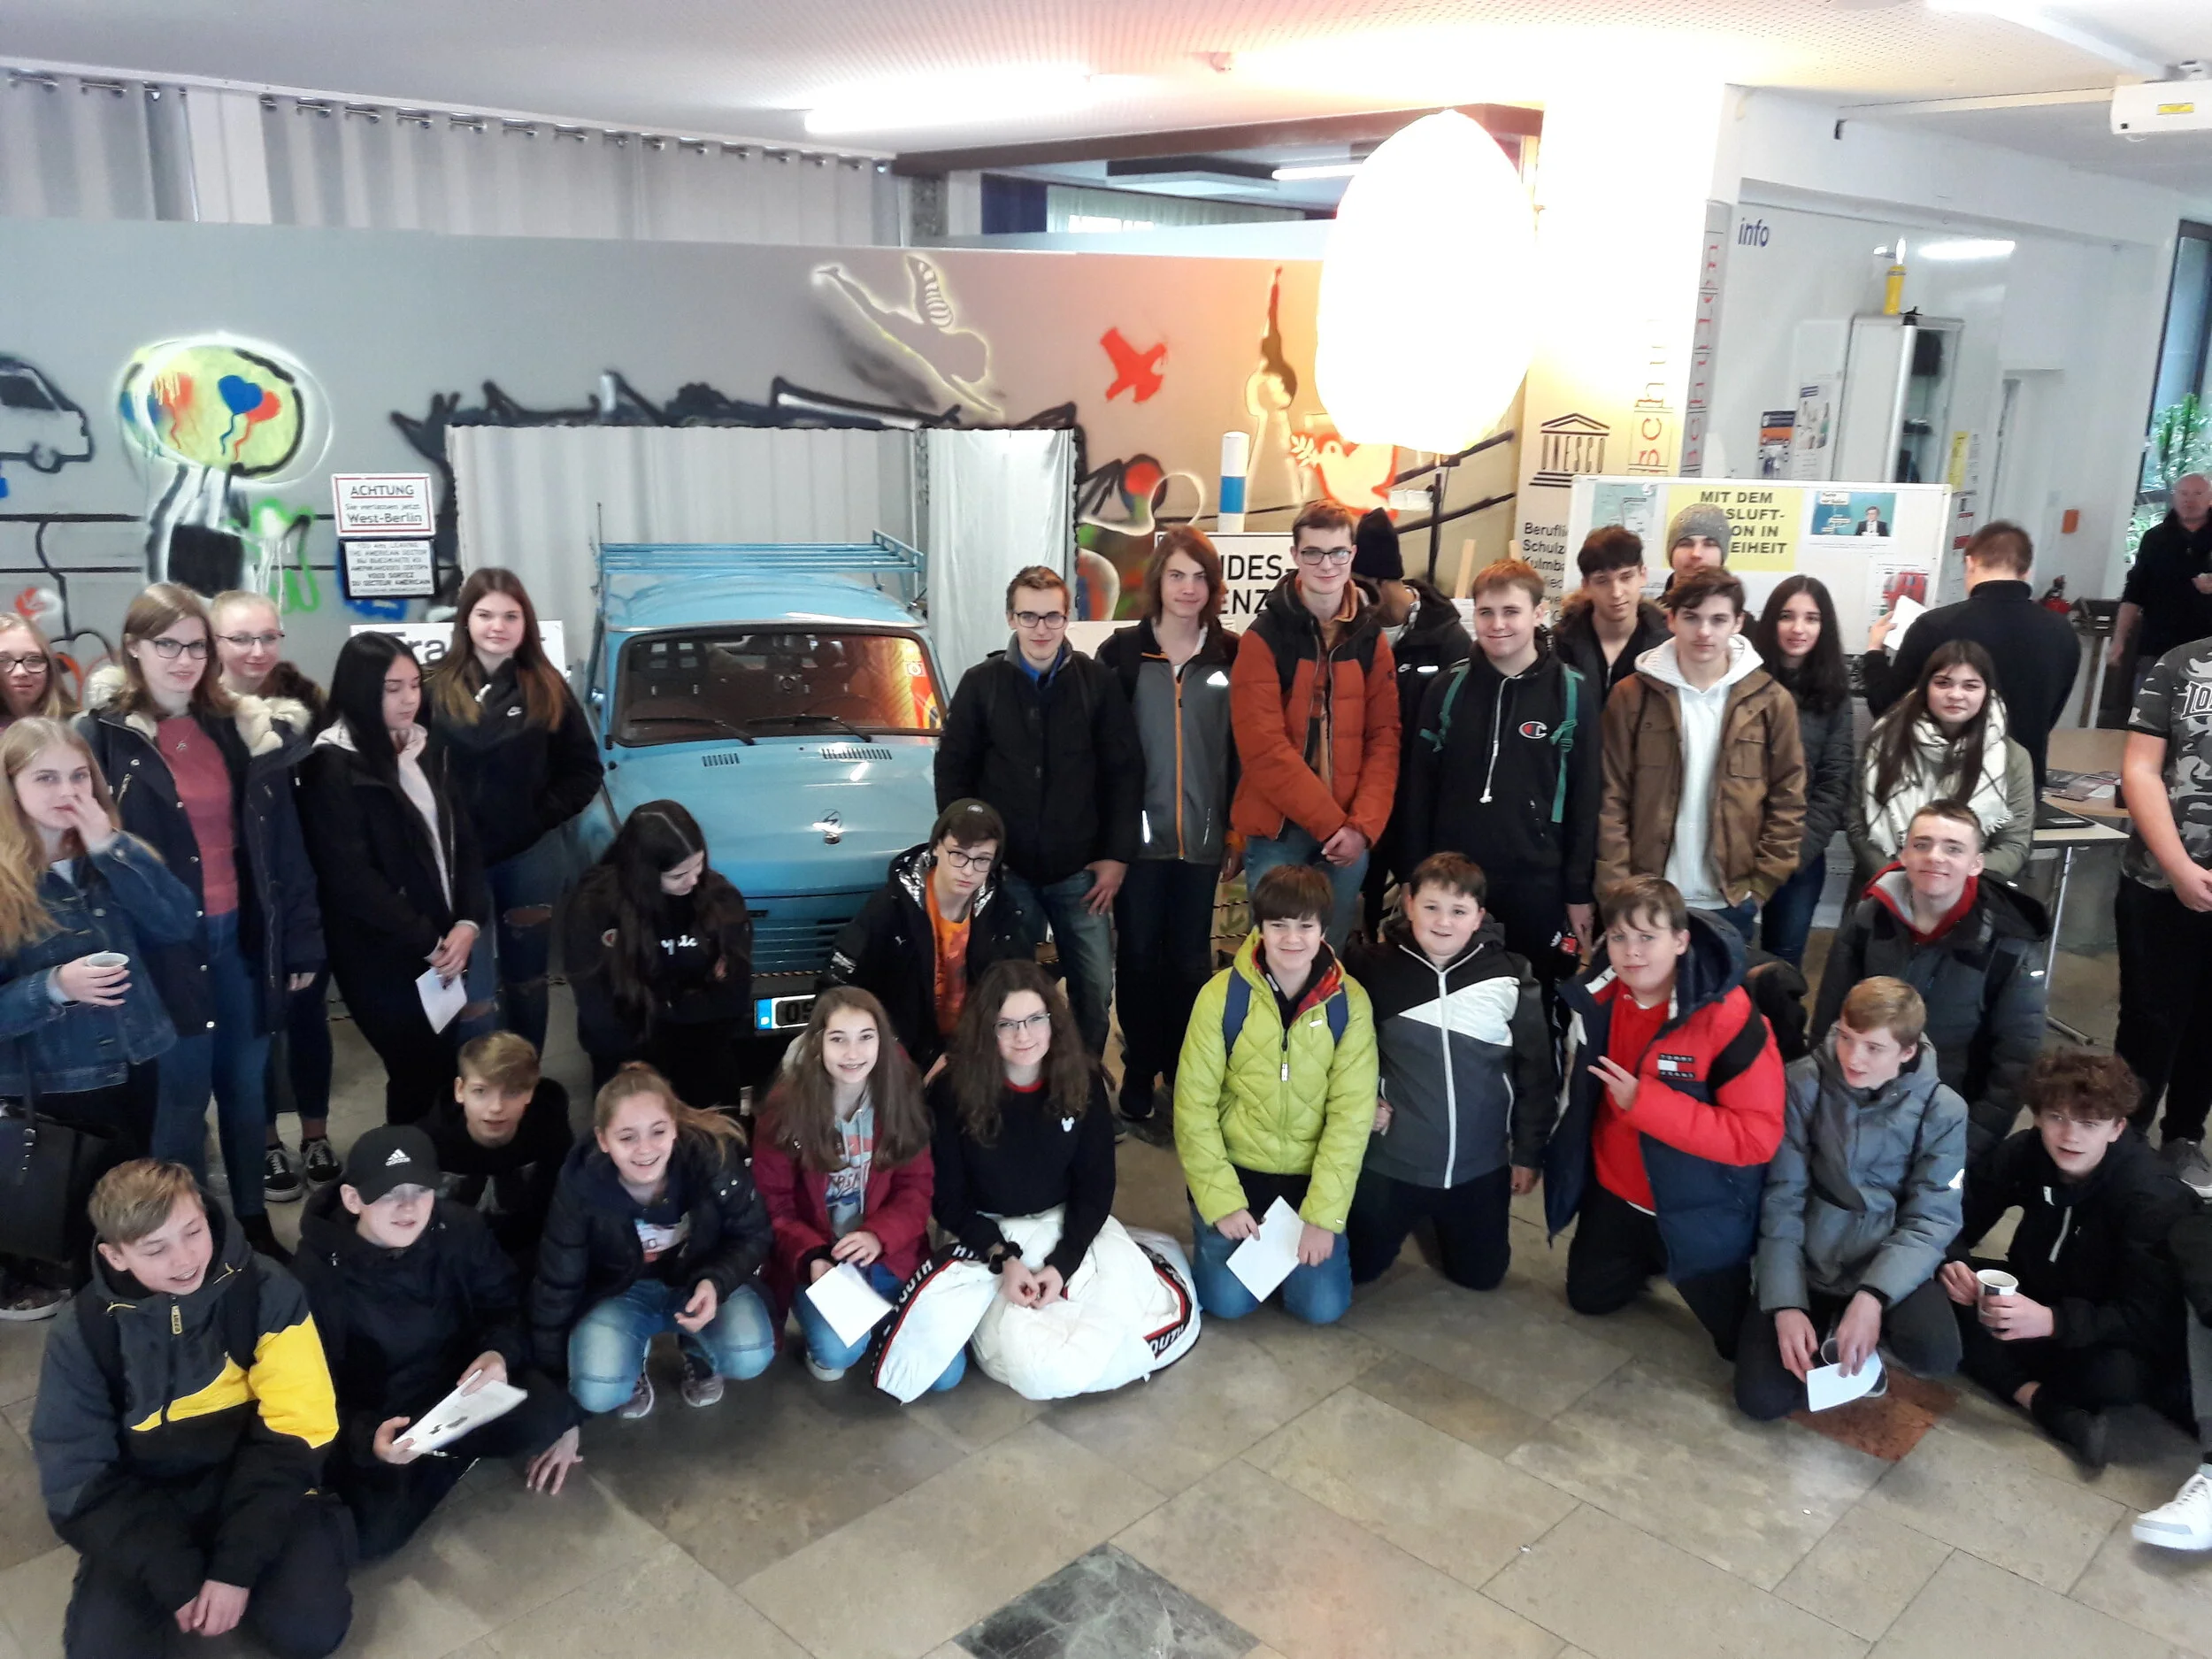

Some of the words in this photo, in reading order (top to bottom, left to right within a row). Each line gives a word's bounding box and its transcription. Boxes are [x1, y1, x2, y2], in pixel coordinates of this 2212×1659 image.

[1738, 217, 1770, 247] info
[1540, 434, 1606, 473] UNESCO
[350, 484, 415, 496] ACHTUNG
[1701, 490, 1732, 503] MIT
[1736, 492, 1774, 504] DEM
[347, 512, 423, 523] West-Berlin
[1724, 508, 1786, 521] SLUFT-
[1525, 522, 1567, 537] Berufli
[1761, 526, 1779, 537] IN
[1523, 540, 1565, 555] Schulz
[1730, 541, 1787, 554] EIHEIT
